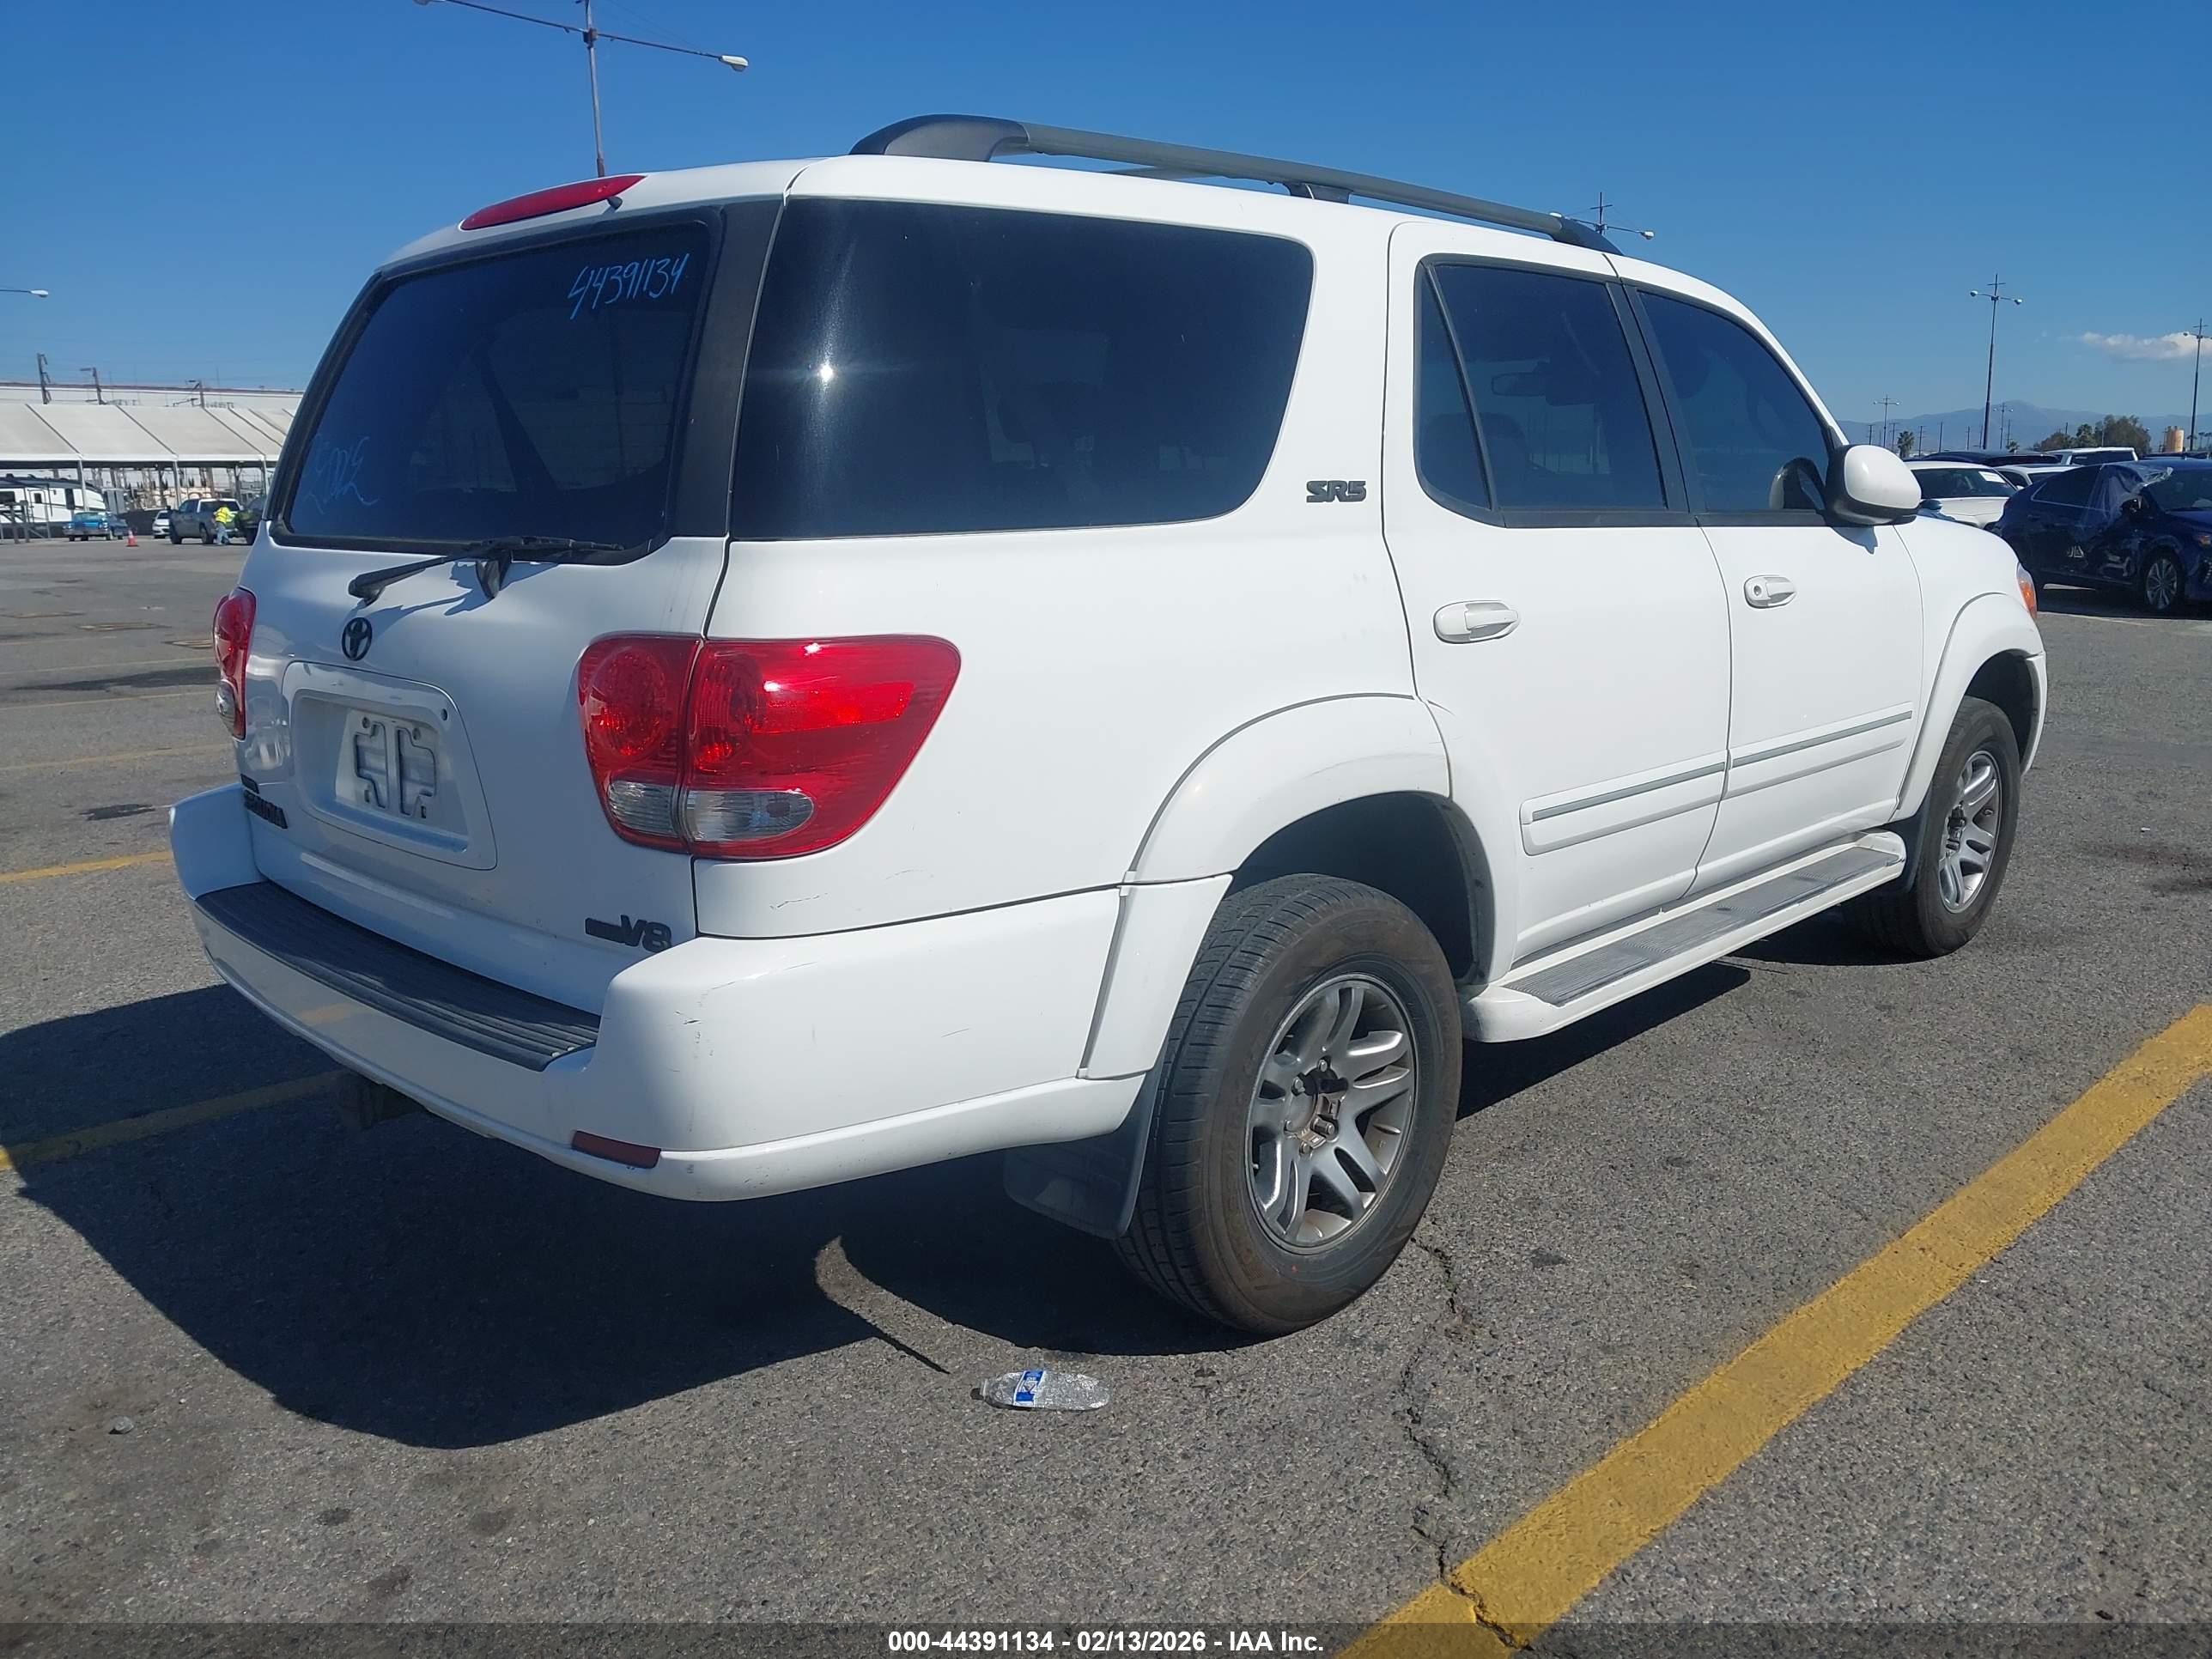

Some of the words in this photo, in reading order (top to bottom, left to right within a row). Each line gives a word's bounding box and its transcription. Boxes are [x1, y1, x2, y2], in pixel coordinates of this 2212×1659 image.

[567, 252, 690, 320] 44391134
[1306, 480, 1367, 503] SR5
[620, 915, 672, 953] V8
